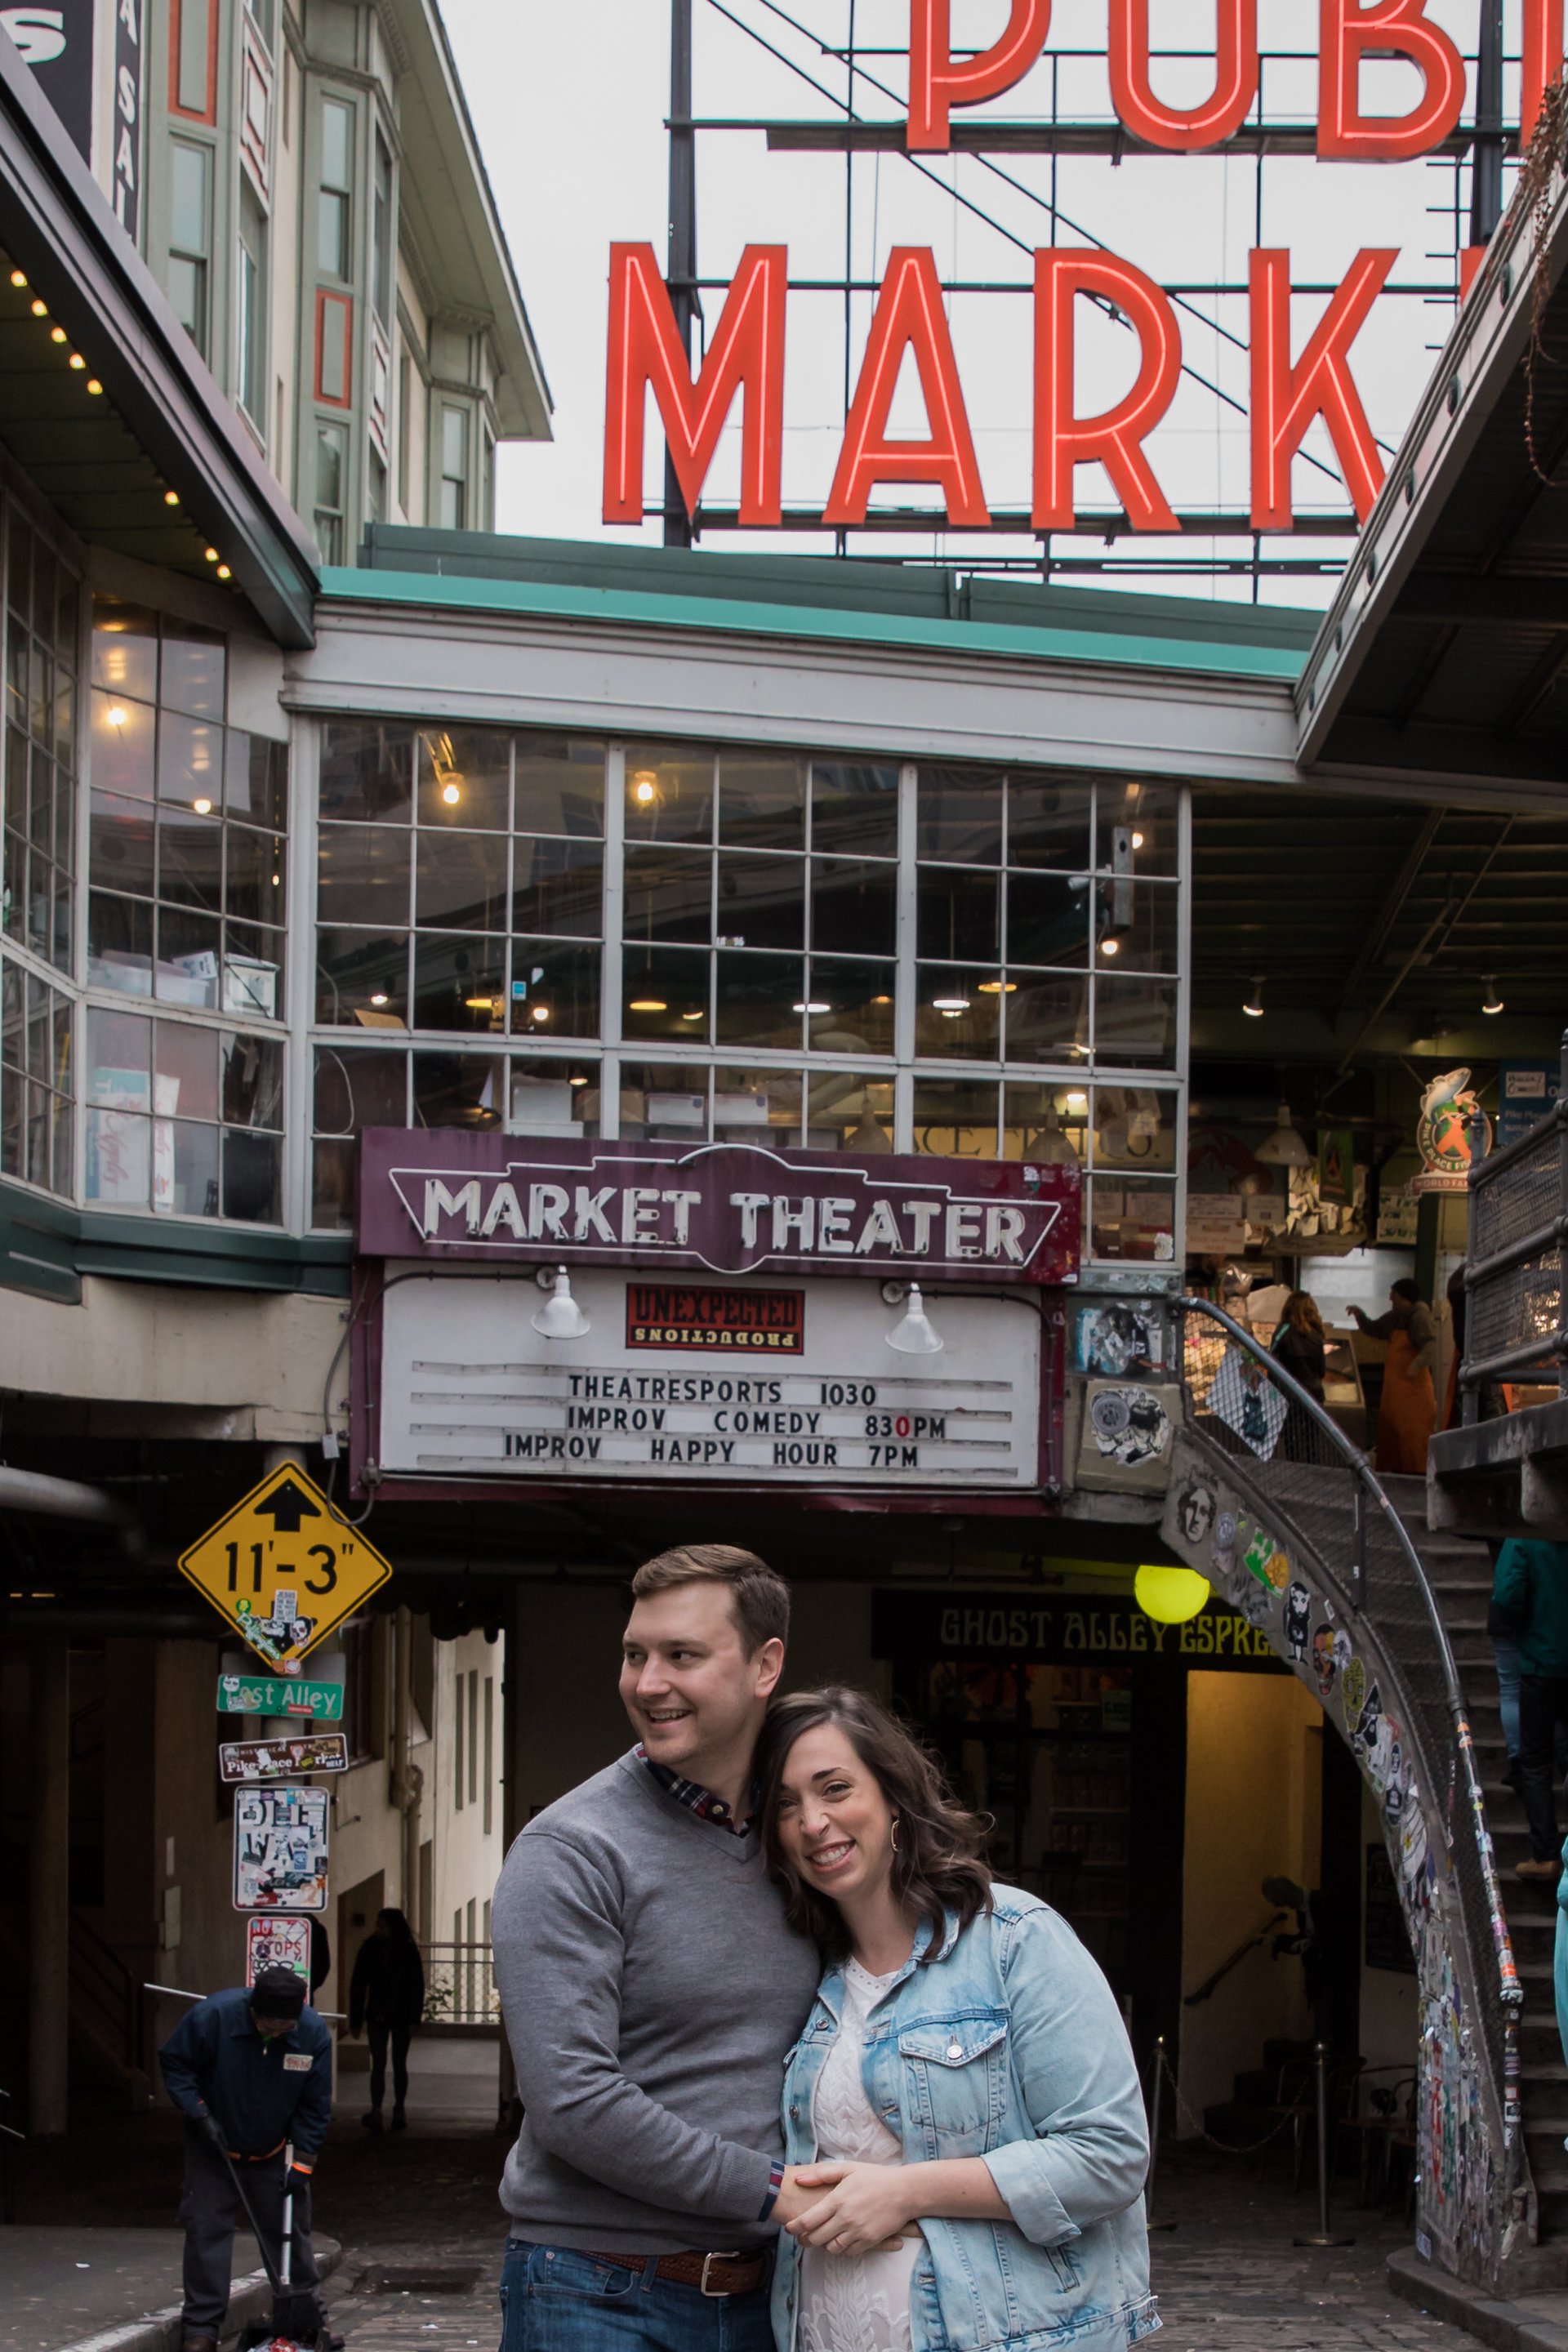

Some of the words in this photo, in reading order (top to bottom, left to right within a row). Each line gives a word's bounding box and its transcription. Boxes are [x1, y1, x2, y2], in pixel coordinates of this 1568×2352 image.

[601, 241, 1486, 532] MARK
[424, 1178, 702, 1246] MARKET
[730, 1192, 1026, 1262] THEATER
[634, 1287, 799, 1328] UNEXPECTED
[635, 1327, 795, 1347] PRODUCTIONS
[568, 1374, 782, 1403] THEATRESPORTS
[821, 1383, 876, 1406] 1030
[568, 1405, 666, 1430] IMPROV
[715, 1410, 821, 1434] COMEDY
[865, 1414, 946, 1439] 830PM
[506, 1434, 602, 1459] IMPROV
[651, 1438, 735, 1463] HAPPY
[773, 1442, 837, 1465] HOUR
[869, 1445, 918, 1468] 7PM
[939, 1608, 1053, 1648] GHOST
[1063, 1611, 1169, 1654] ALLEY
[282, 1684, 336, 1715] Alley
[227, 1759, 256, 1773] Pike
